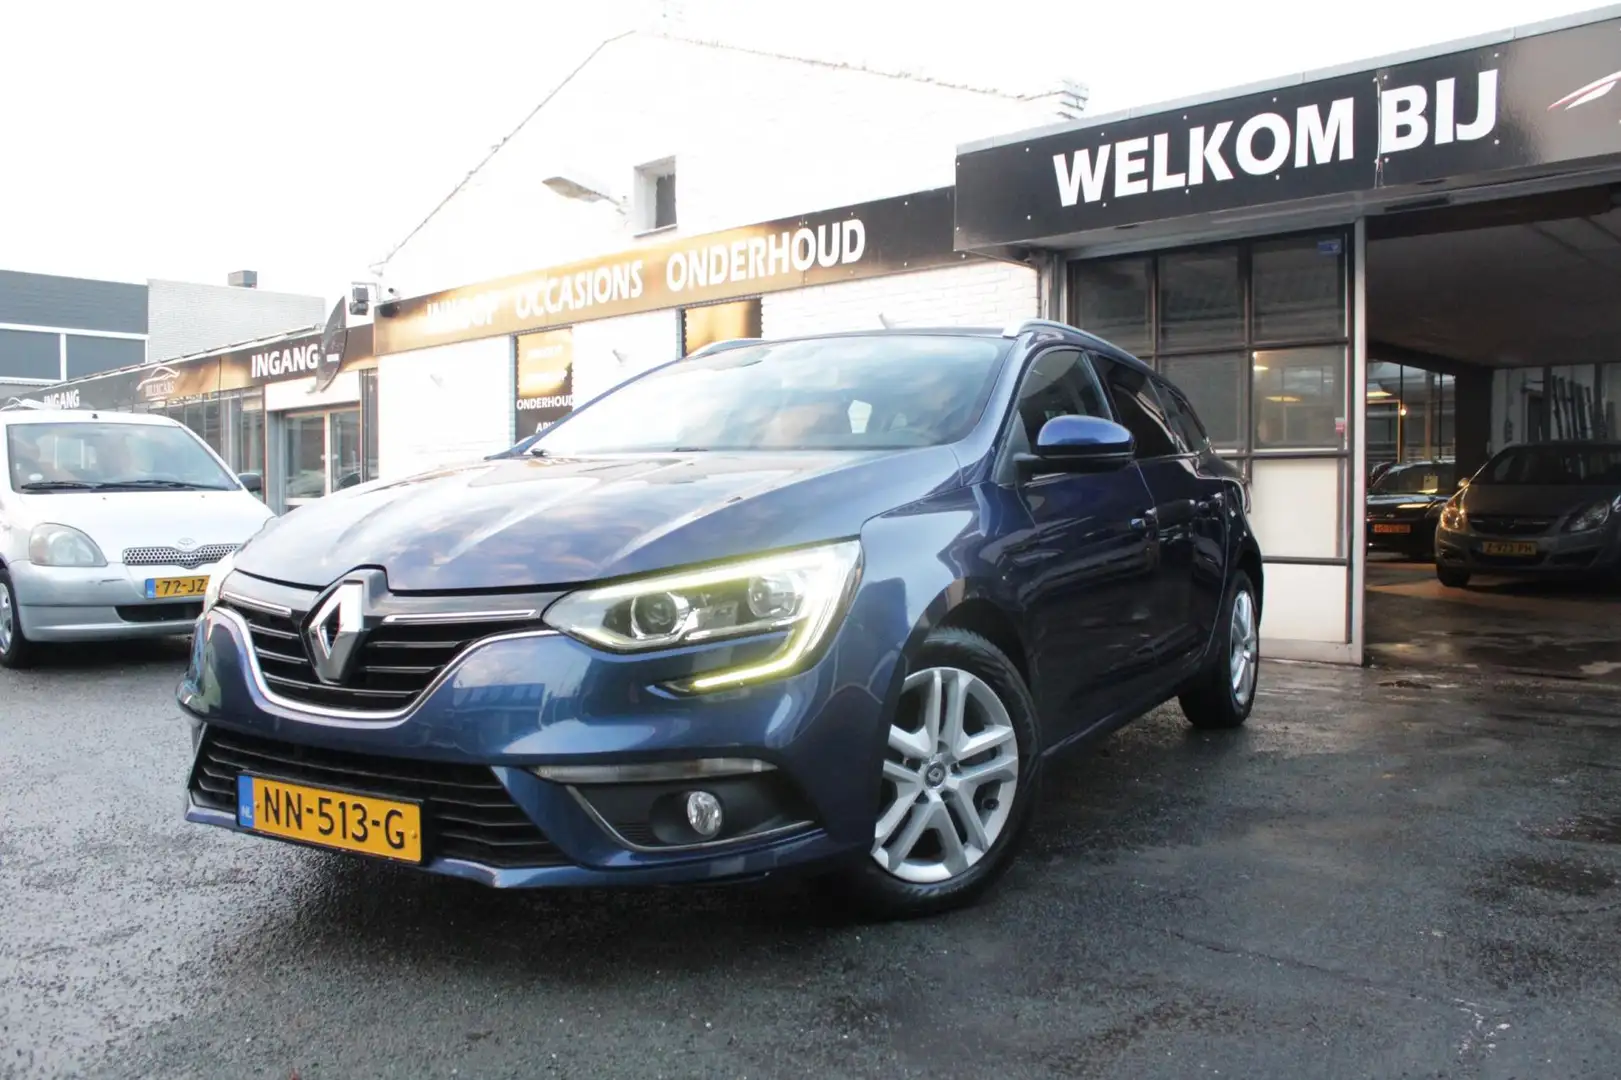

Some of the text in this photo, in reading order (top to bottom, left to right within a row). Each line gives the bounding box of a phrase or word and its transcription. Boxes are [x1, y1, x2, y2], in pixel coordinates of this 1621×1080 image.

[1052, 69, 1498, 207] WELKOM BIJ
[515, 259, 643, 319] OCCASIONS
[665, 219, 866, 292] ONDERHOUD
[251, 343, 319, 378] INGANG
[536, 421, 555, 433] AP
[263, 785, 405, 850] NN-513-G
